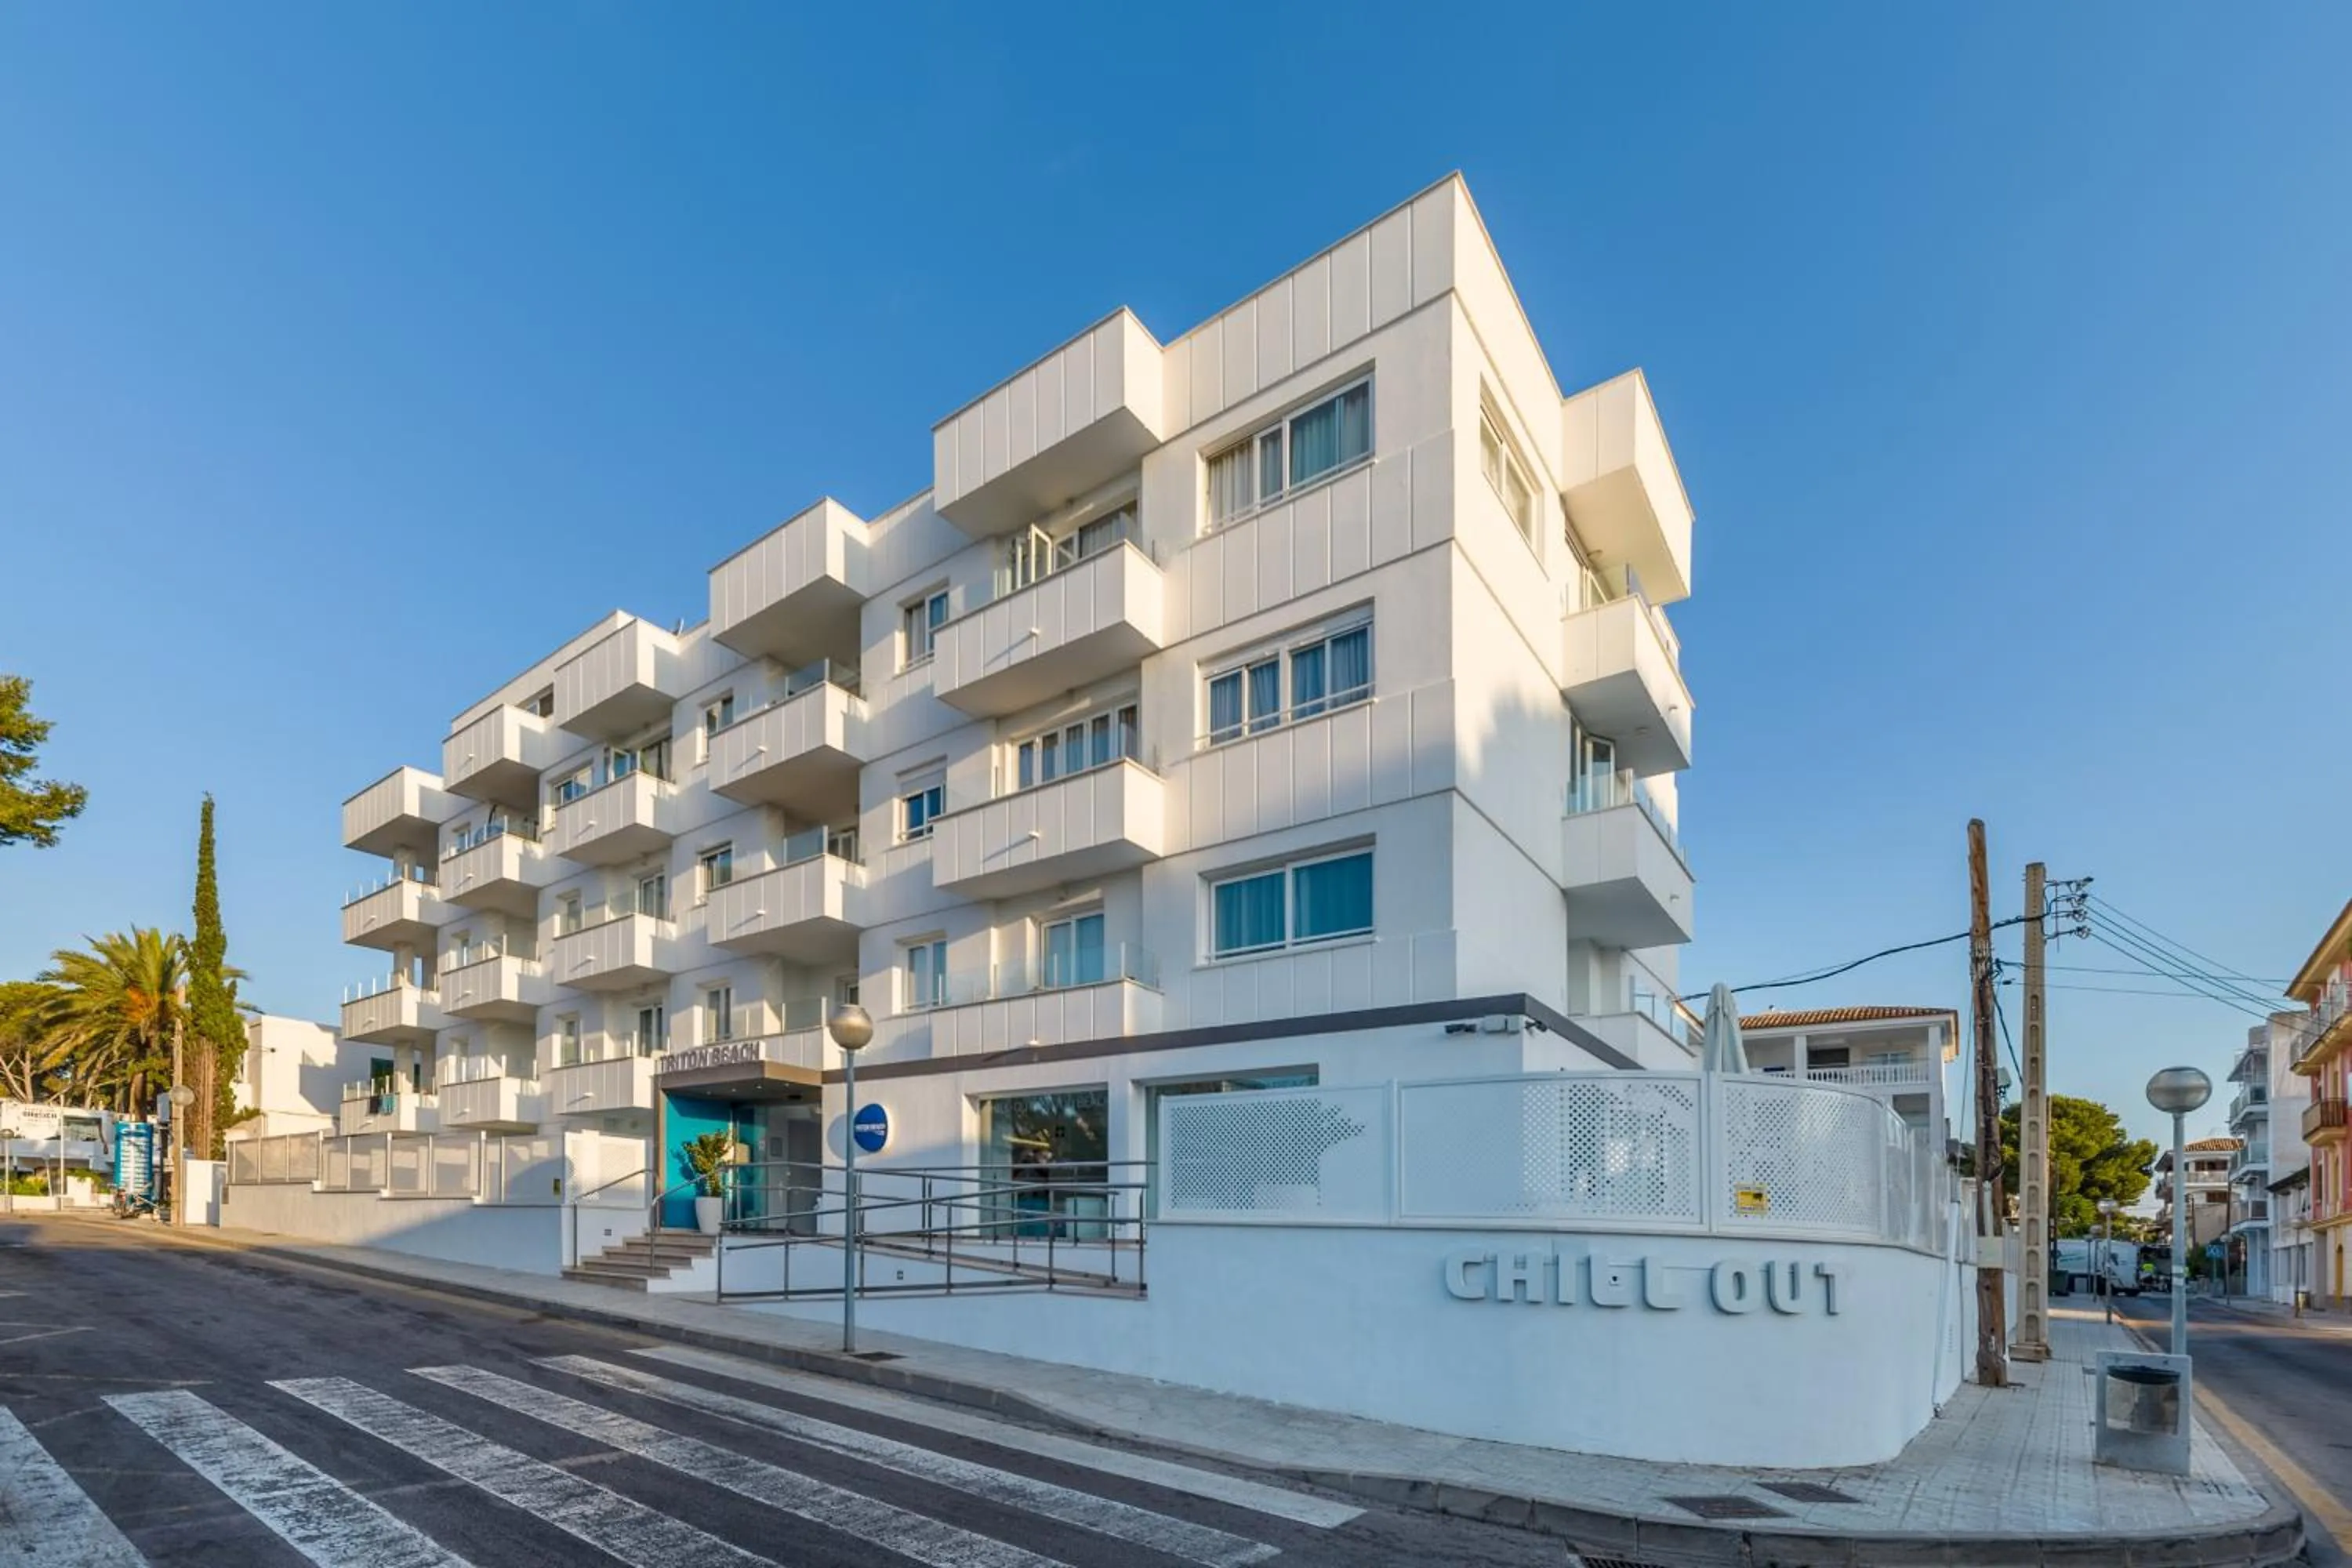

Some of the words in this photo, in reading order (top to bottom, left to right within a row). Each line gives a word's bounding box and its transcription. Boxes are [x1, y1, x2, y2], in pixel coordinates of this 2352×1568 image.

[659, 1048, 707, 1074] TRITON
[712, 1040, 760, 1065] BEACH
[1444, 1250, 1682, 1312] CHILL
[1709, 1258, 1852, 1316] OUT
